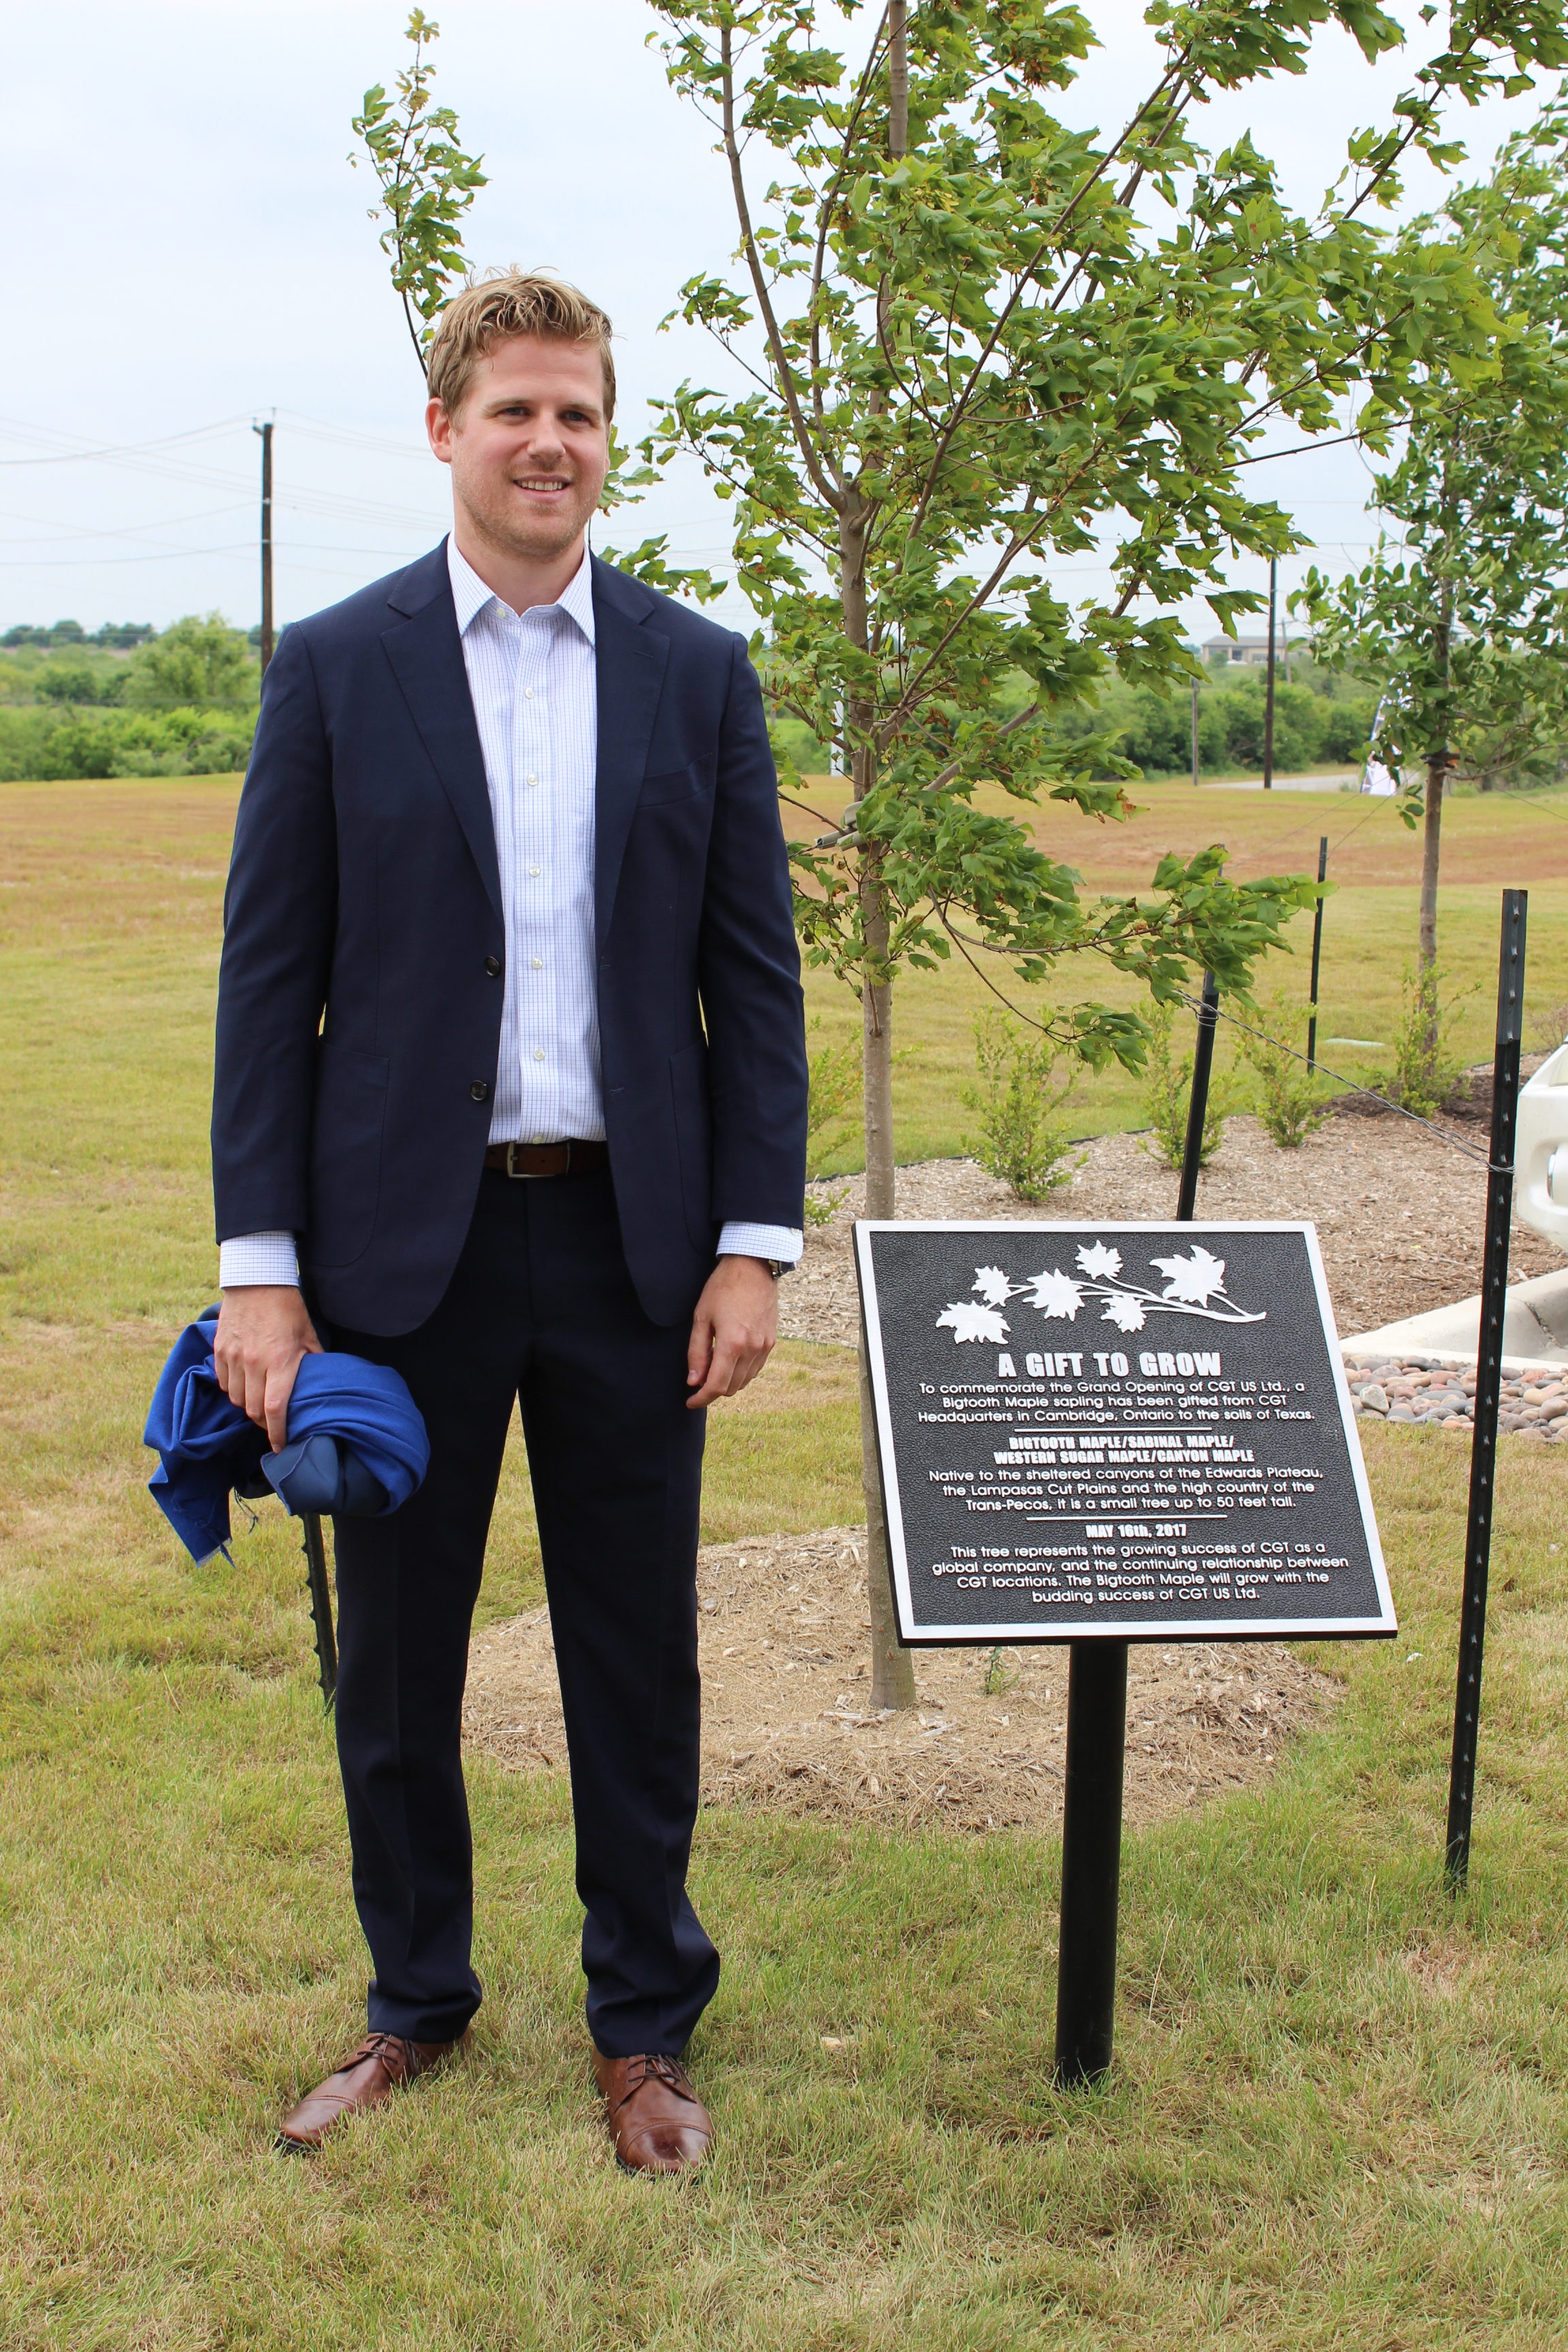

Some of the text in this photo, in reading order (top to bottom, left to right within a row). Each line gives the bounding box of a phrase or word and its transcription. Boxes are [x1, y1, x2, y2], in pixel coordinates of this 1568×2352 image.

[998, 1352, 1221, 1377] A GIFT TO GROW
[919, 1381, 1305, 1394] To commemorate the Grand Opening of CGT US Ltd., a
[943, 1394, 1287, 1410] Bigtooth Maple sapling has been gifted from CGT
[918, 1409, 1315, 1424] Headquarters in Cambridge, Ontario to the soils of Texas.
[1009, 1436, 1076, 1450] BIGTOOTH
[993, 1451, 1056, 1465] WESTERN
[1060, 1450, 1105, 1464] SUGAR
[1211, 1449, 1255, 1462] MAPLE
[929, 1467, 1323, 1482] Native to the sheltered canyons of the Edwards Plateau,
[942, 1481, 1315, 1497] the Lampasas Cut Plains and the high country of the
[965, 1496, 1296, 1511] Trans-Pecos, it is a small tree up to 50 feet tall.
[1085, 1523, 1187, 1538] MAY 16th, 2017
[950, 1541, 1326, 1558] This tree represents the growing success of CGT as a
[932, 1556, 1349, 1576] global company, and the continuing relationship between
[957, 1571, 1329, 1588] CGT locations. The Bigtooth Maple will grow with the
[1032, 1587, 1260, 1604] budding success of CGT US Ltd.
